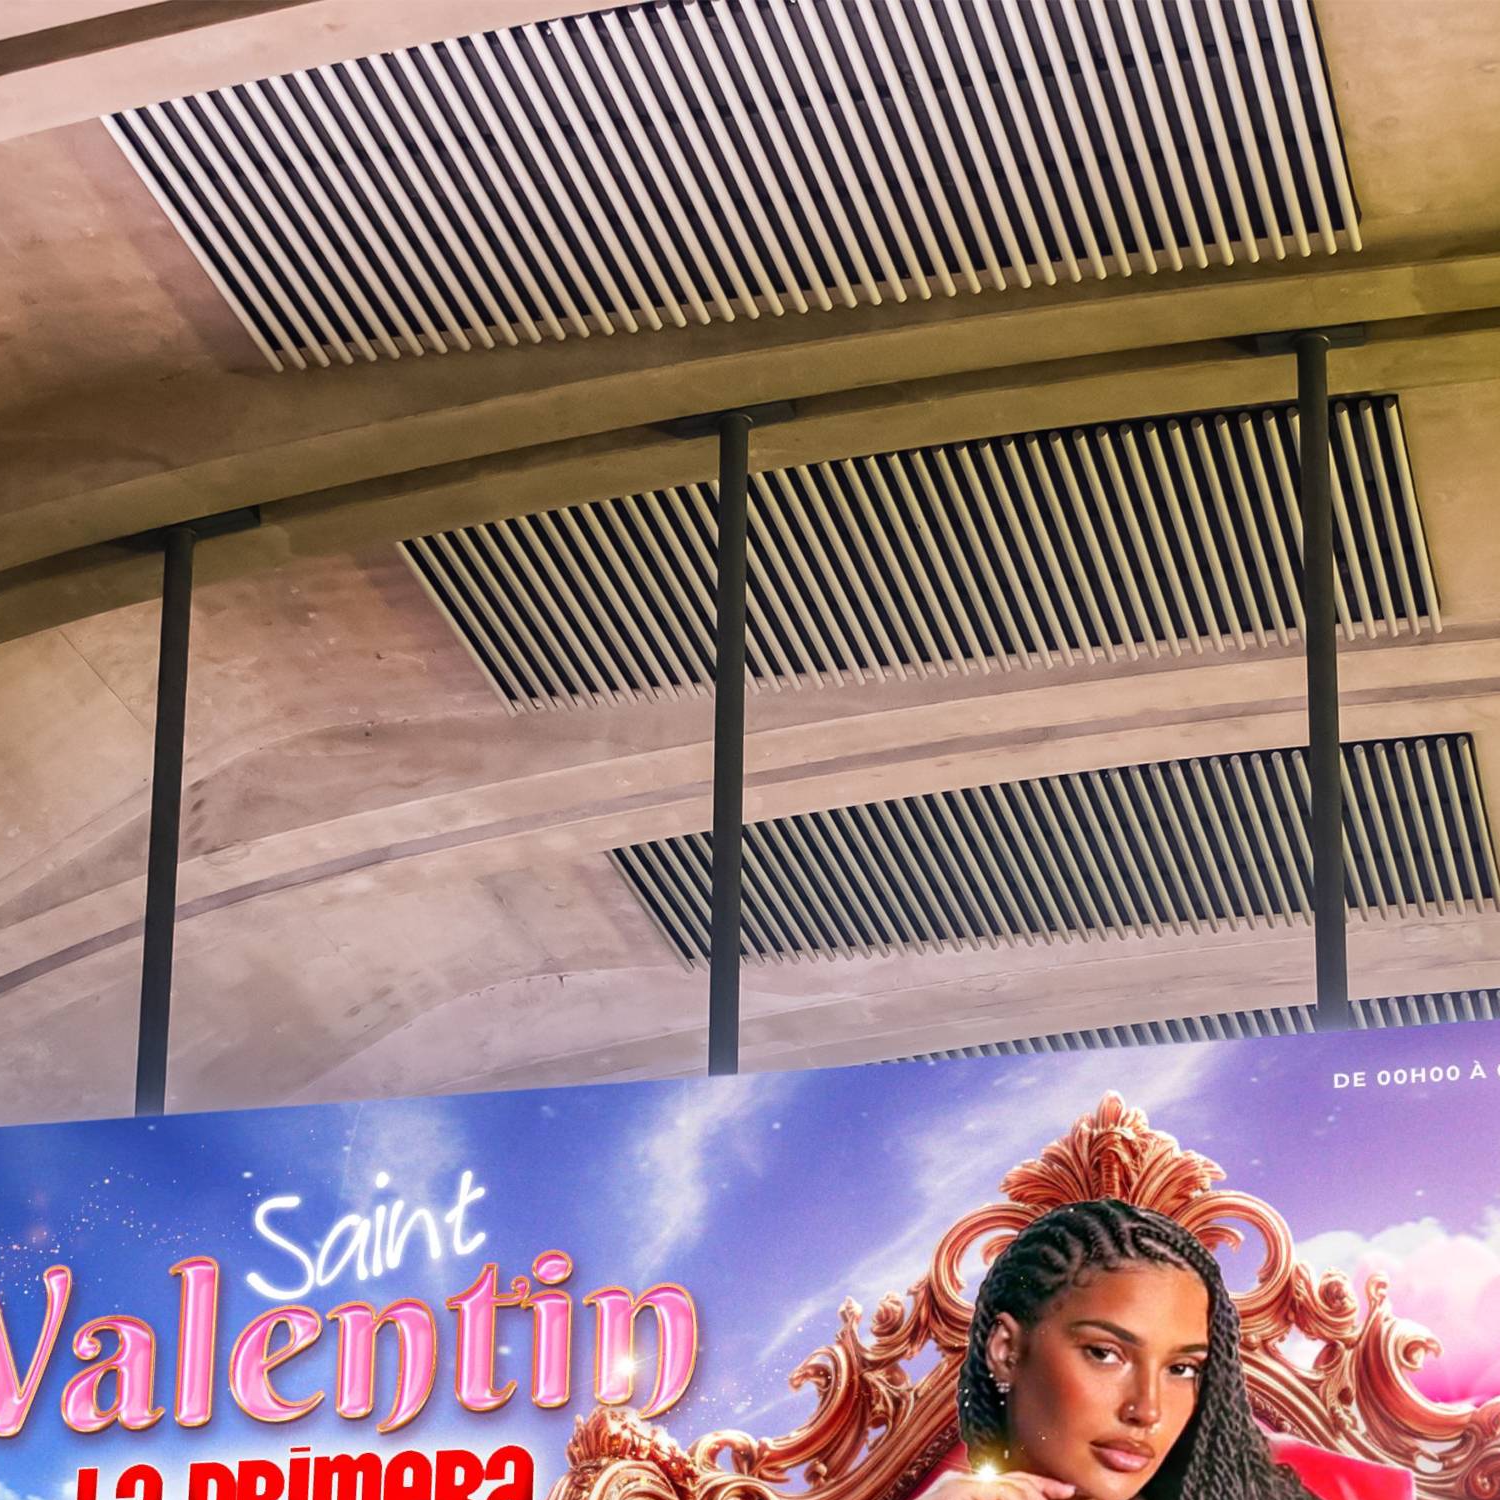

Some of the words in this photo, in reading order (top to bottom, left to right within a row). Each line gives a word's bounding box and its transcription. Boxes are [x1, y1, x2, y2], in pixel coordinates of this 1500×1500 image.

[1333, 1072, 1367, 1088] DE
[1377, 1065, 1460, 1086] 00H00
[246, 1169, 488, 1300] Saint
